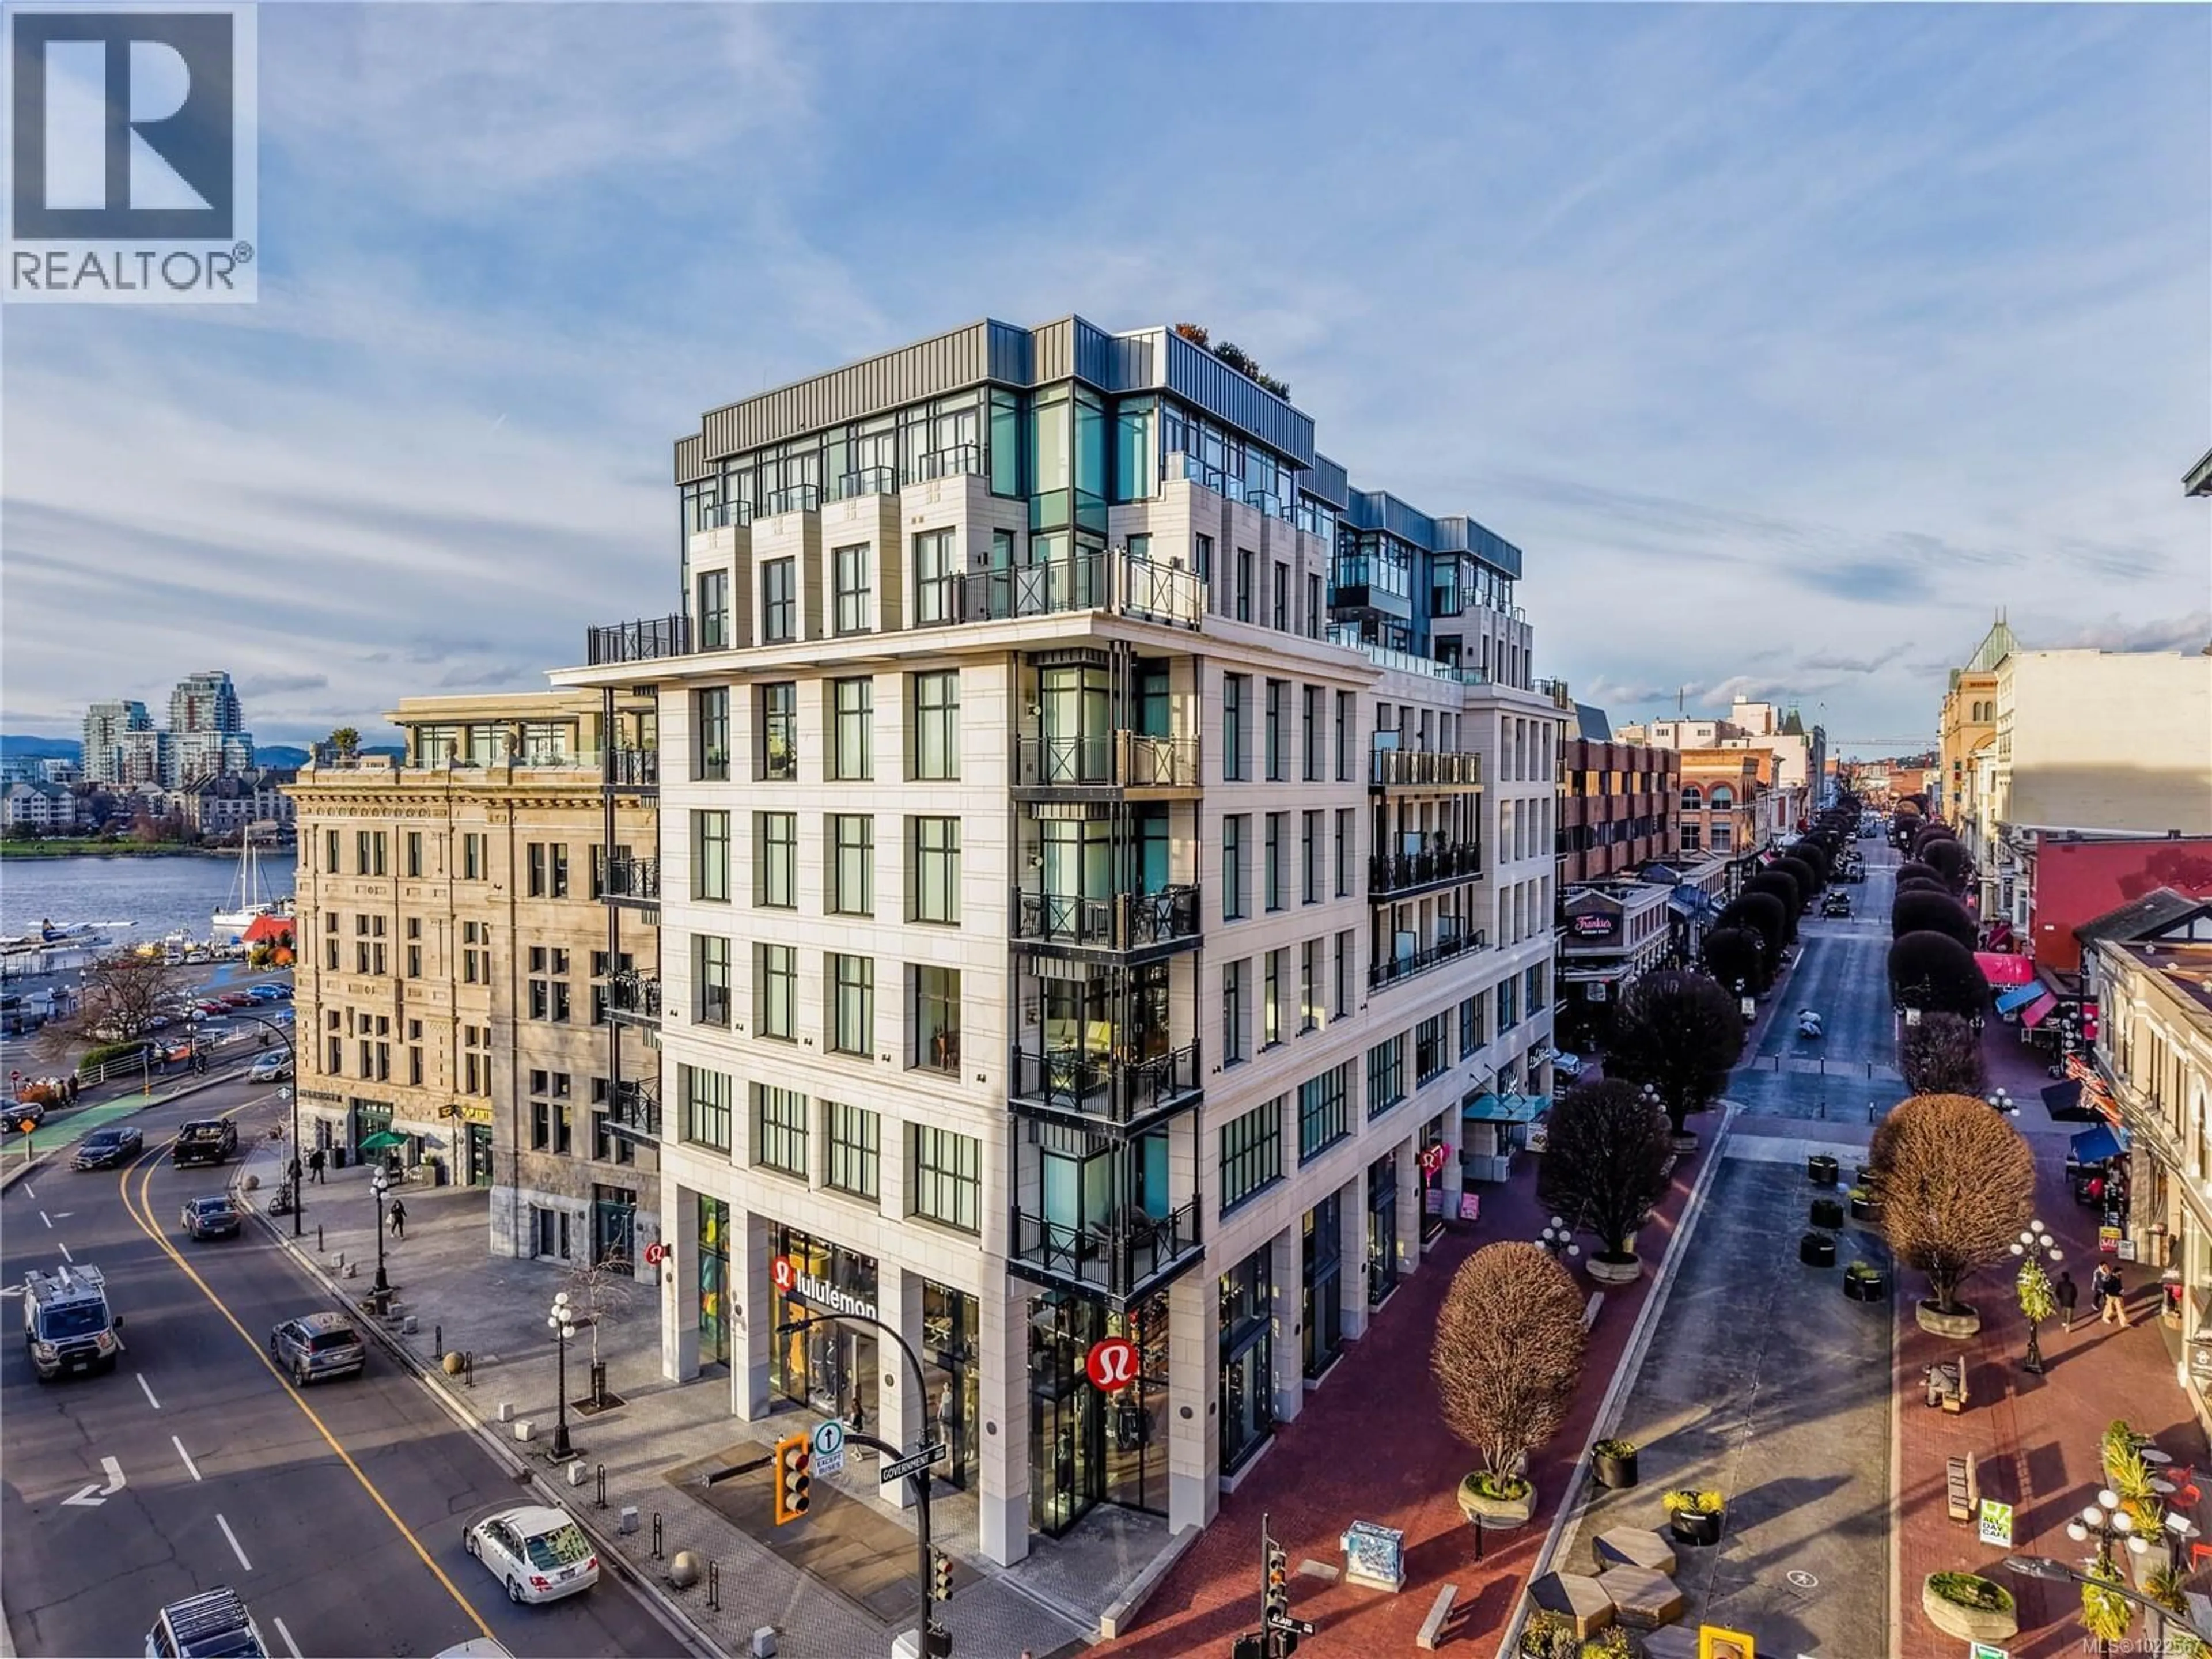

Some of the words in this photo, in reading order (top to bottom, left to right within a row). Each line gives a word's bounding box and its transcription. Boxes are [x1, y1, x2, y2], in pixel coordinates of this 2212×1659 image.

[797, 1270, 876, 1319] lululemon
[817, 1453, 841, 1467] EXCEPT
[884, 1454, 929, 1480] GOVERNMENT
[1982, 1522, 2003, 1531] DAY
